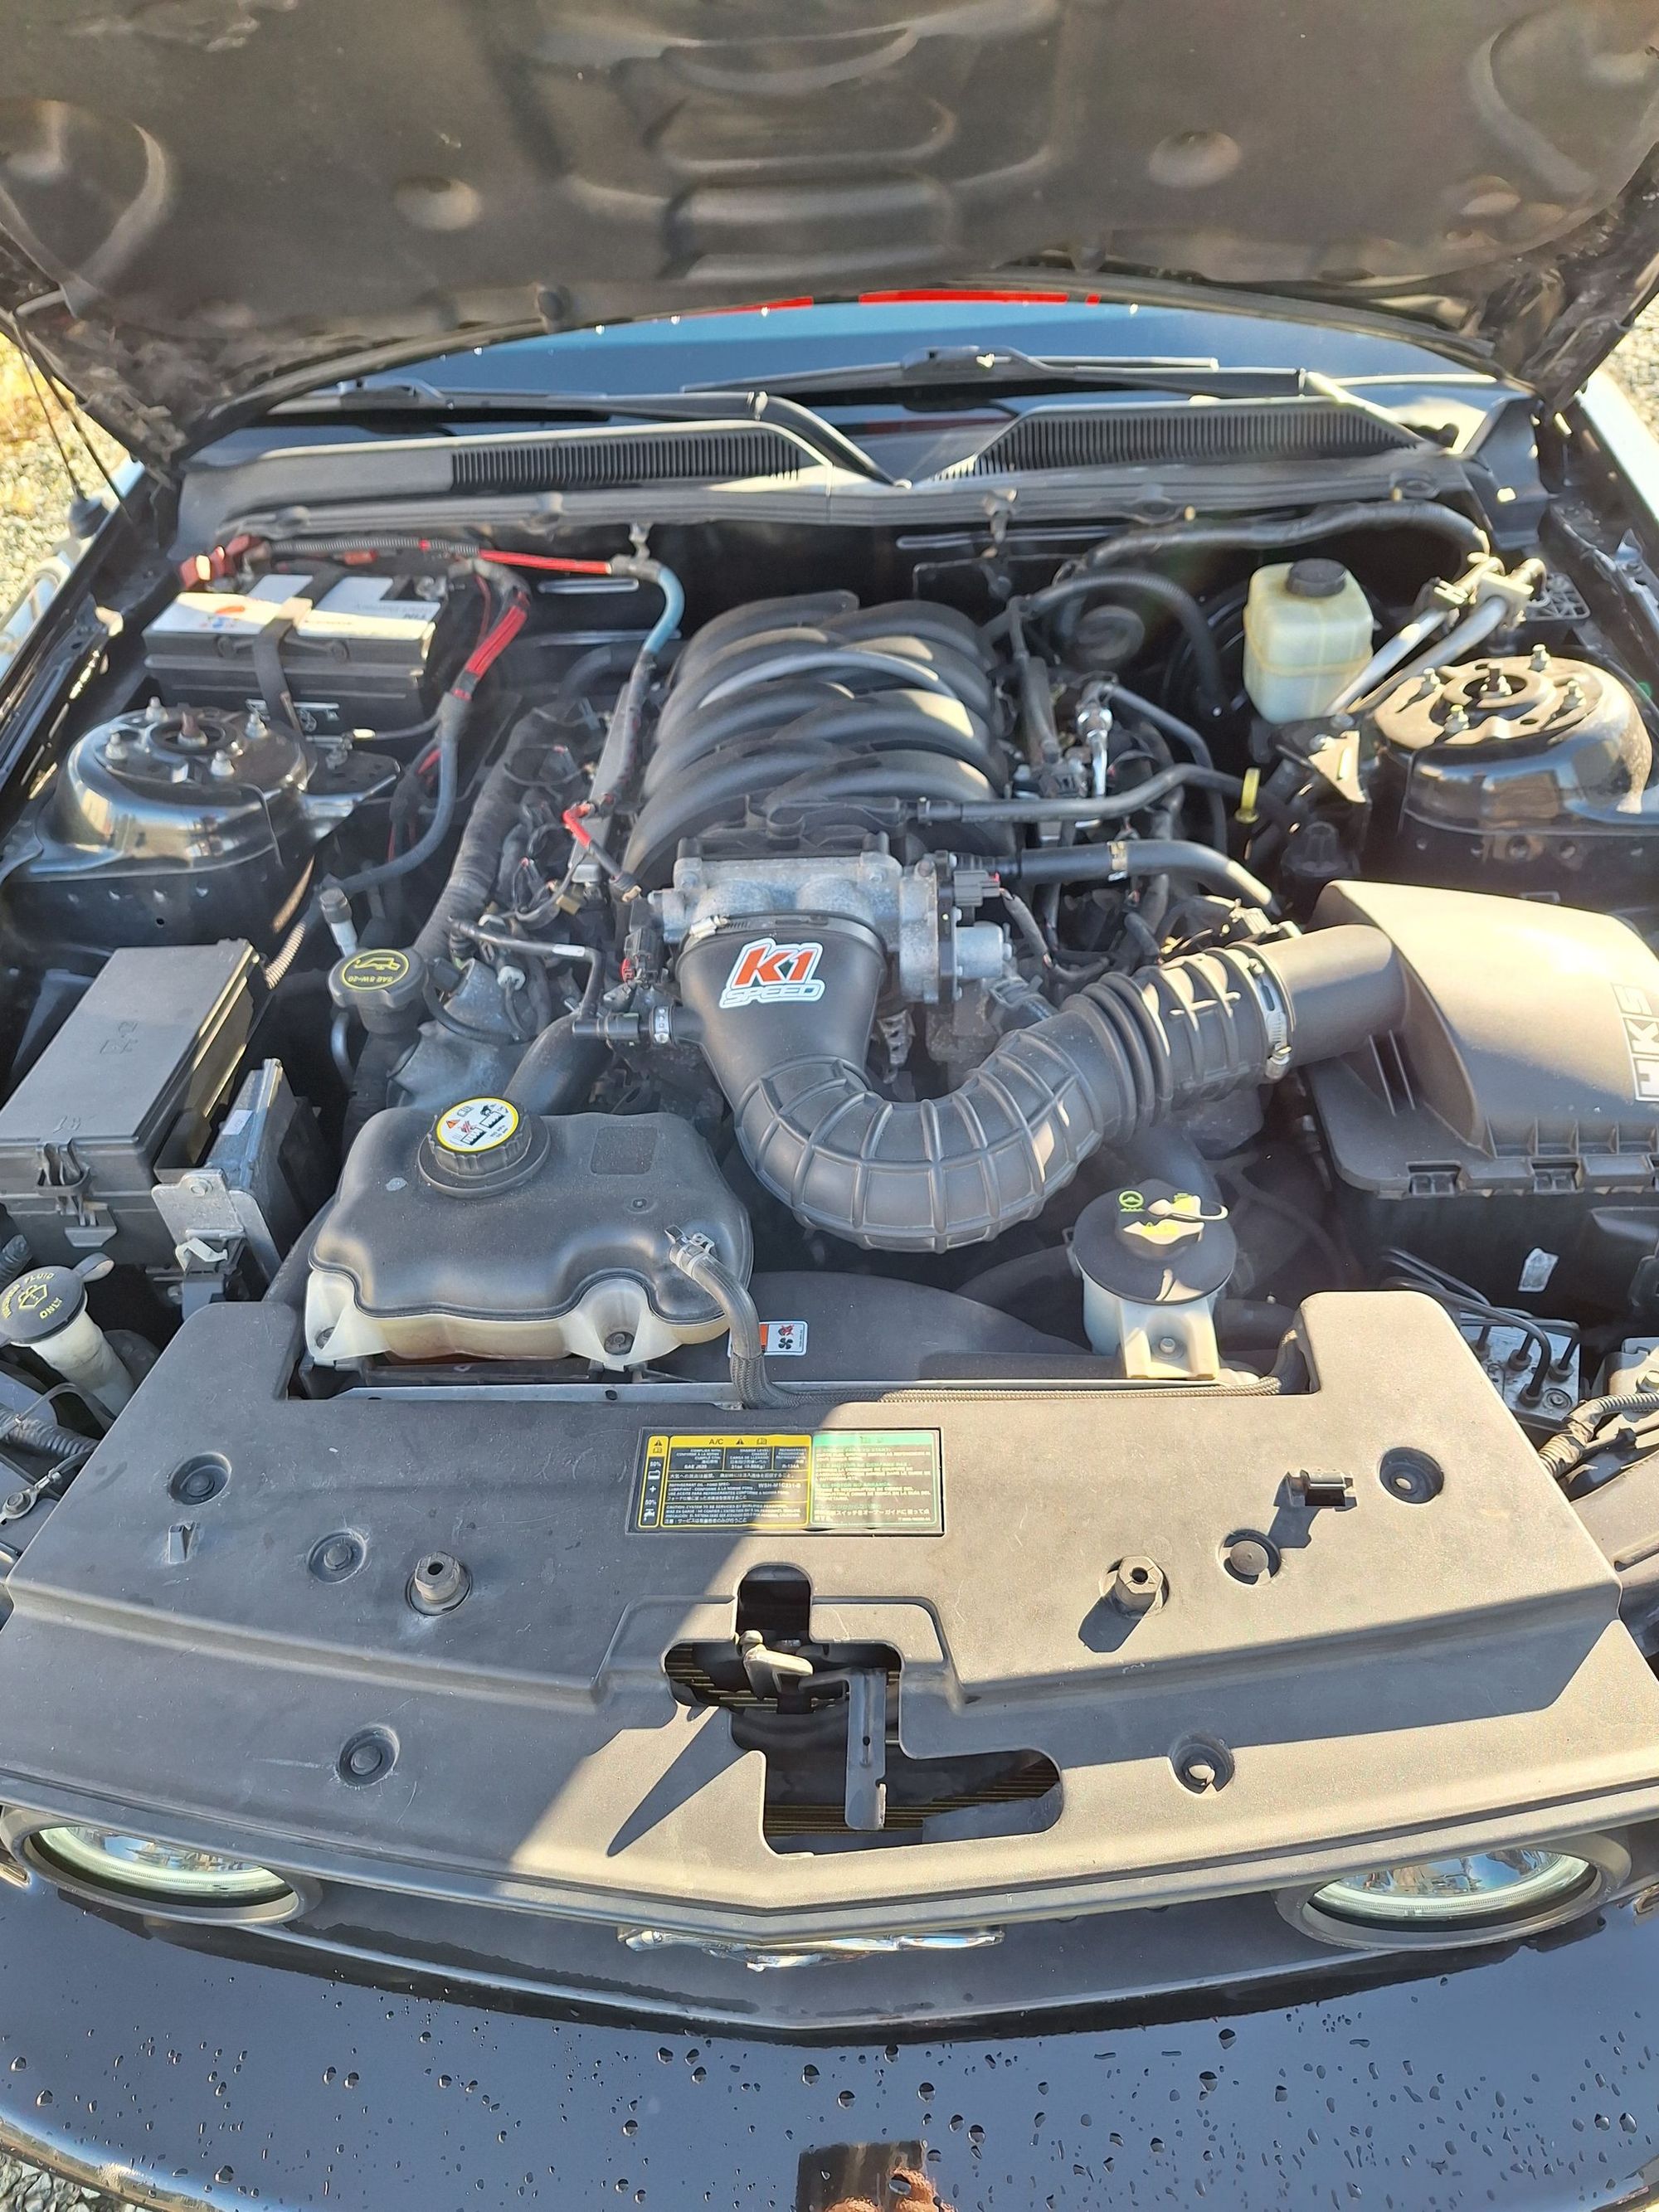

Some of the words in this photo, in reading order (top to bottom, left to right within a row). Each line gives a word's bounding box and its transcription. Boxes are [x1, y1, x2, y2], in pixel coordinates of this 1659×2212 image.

[732, 944, 818, 988] K1
[722, 984, 821, 1005] SPEED
[39, 1296, 63, 1320] ONLY
